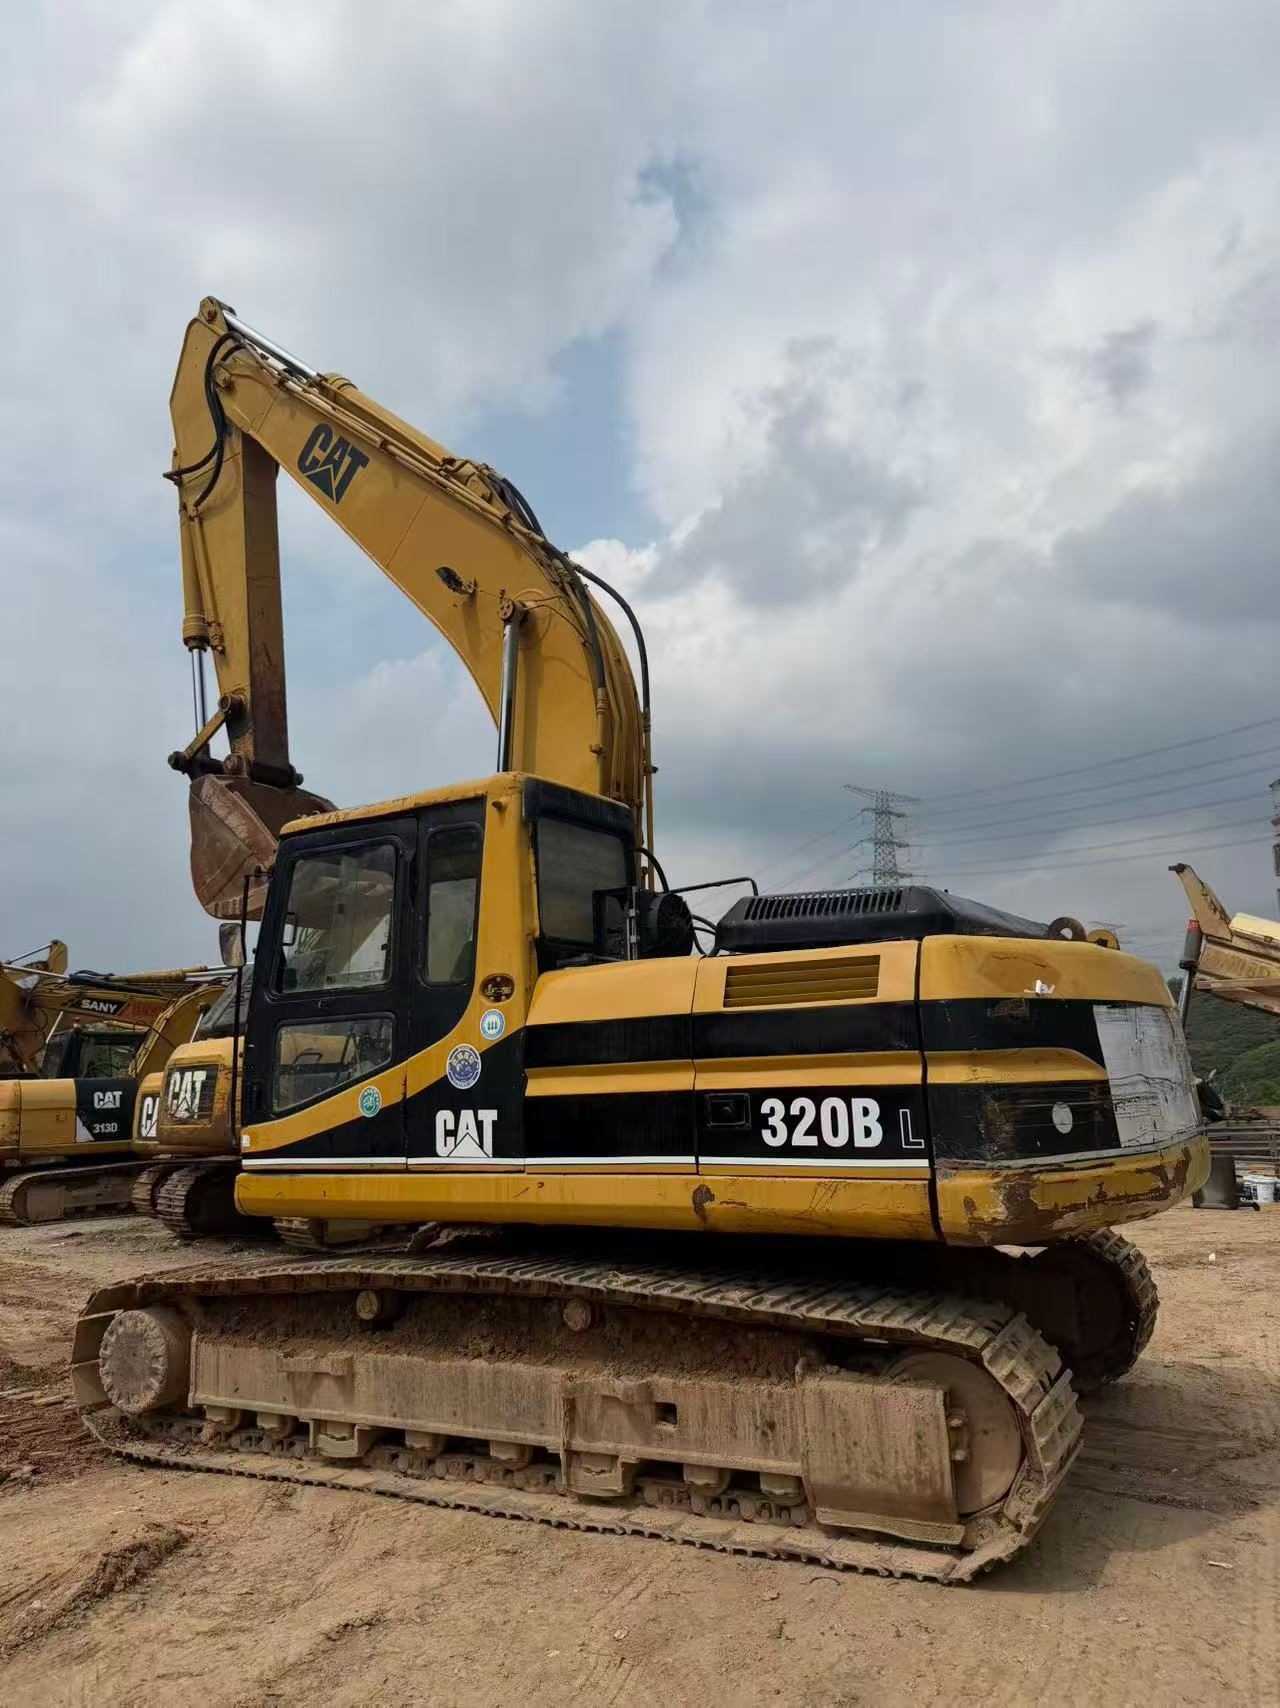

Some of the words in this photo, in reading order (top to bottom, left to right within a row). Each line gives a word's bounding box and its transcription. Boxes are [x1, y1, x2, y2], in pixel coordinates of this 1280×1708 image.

[298, 423, 370, 504] CAT
[81, 999, 117, 1014] SANY
[93, 1091, 122, 1109] CAT
[141, 1096, 160, 1138] CA
[168, 1070, 207, 1119] CAT
[92, 1122, 118, 1134] 313D
[435, 1109, 498, 1158] CAT
[760, 1097, 883, 1148] 320B
[899, 1109, 925, 1149] L
